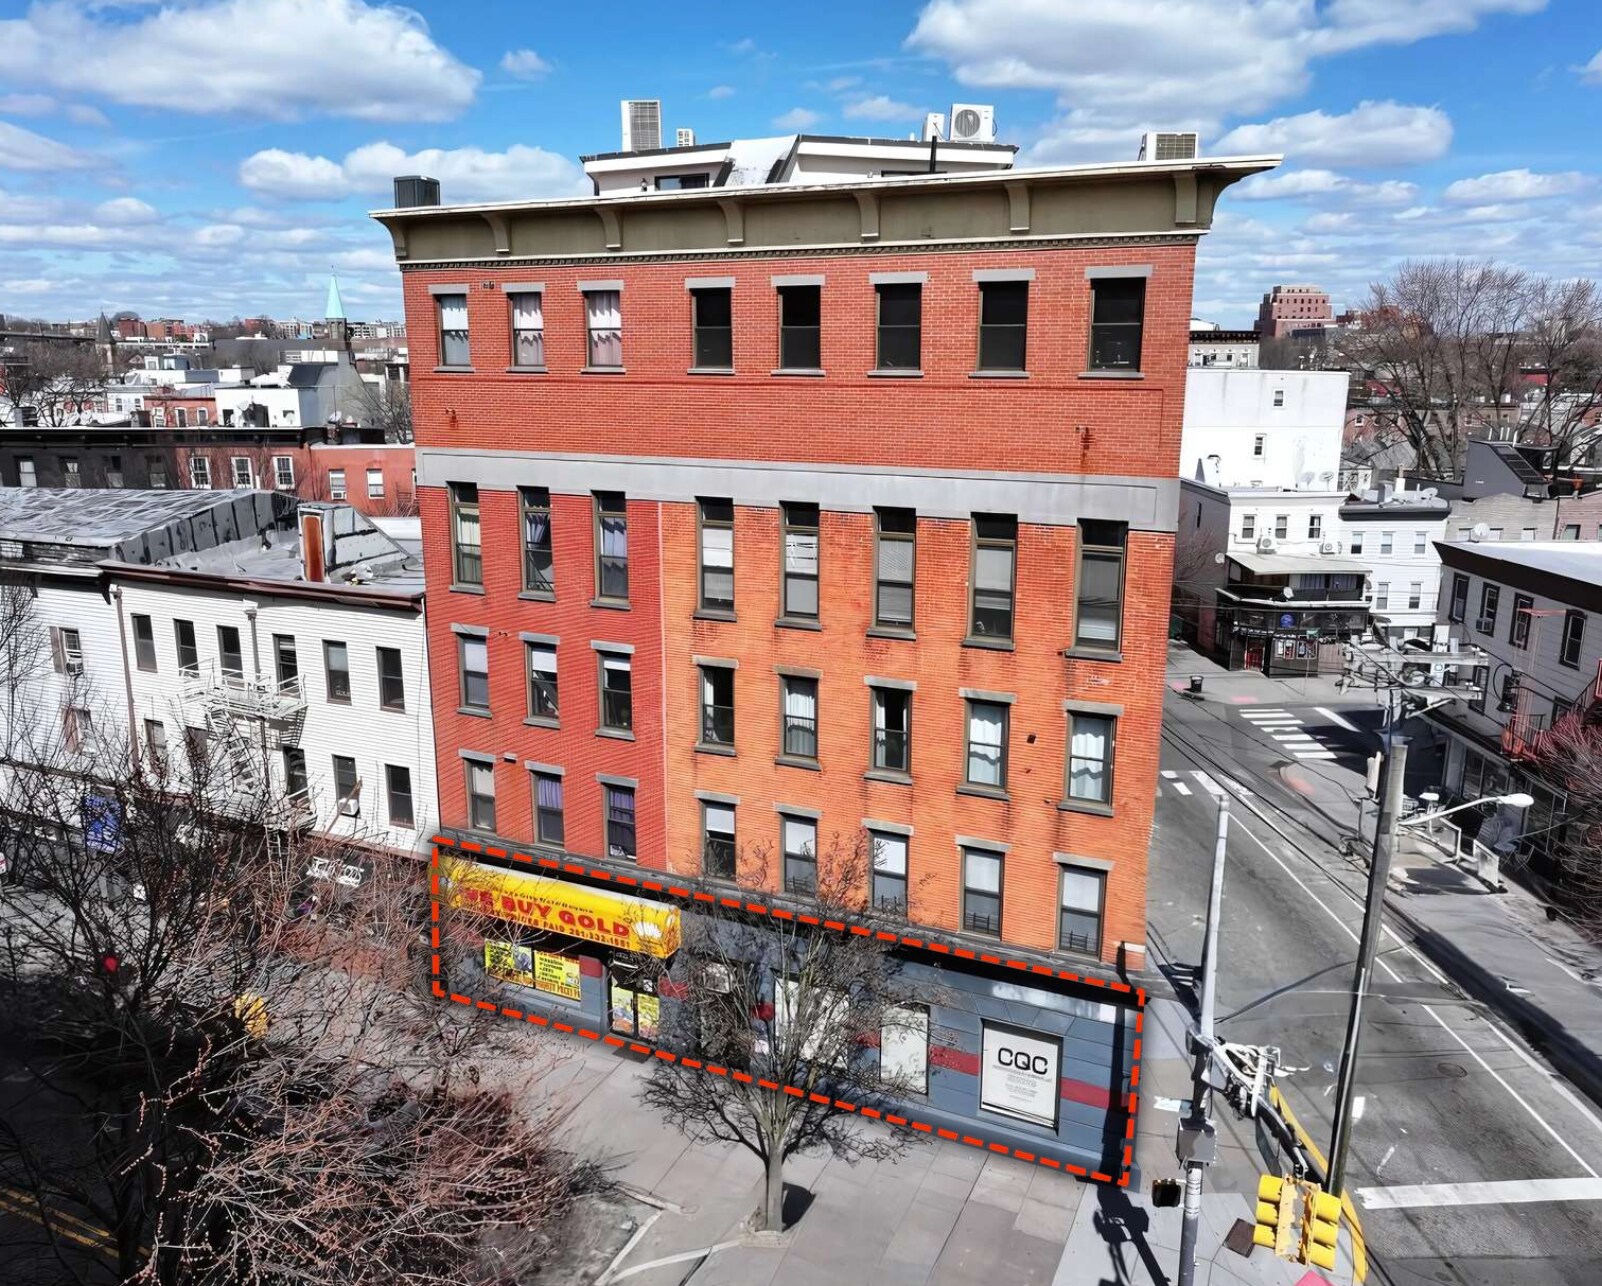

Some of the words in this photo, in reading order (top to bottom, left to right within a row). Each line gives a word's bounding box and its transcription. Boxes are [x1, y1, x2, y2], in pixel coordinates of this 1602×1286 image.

[501, 895, 551, 918] BUY
[559, 910, 630, 937] GOLD
[998, 1047, 1048, 1075] CQC
